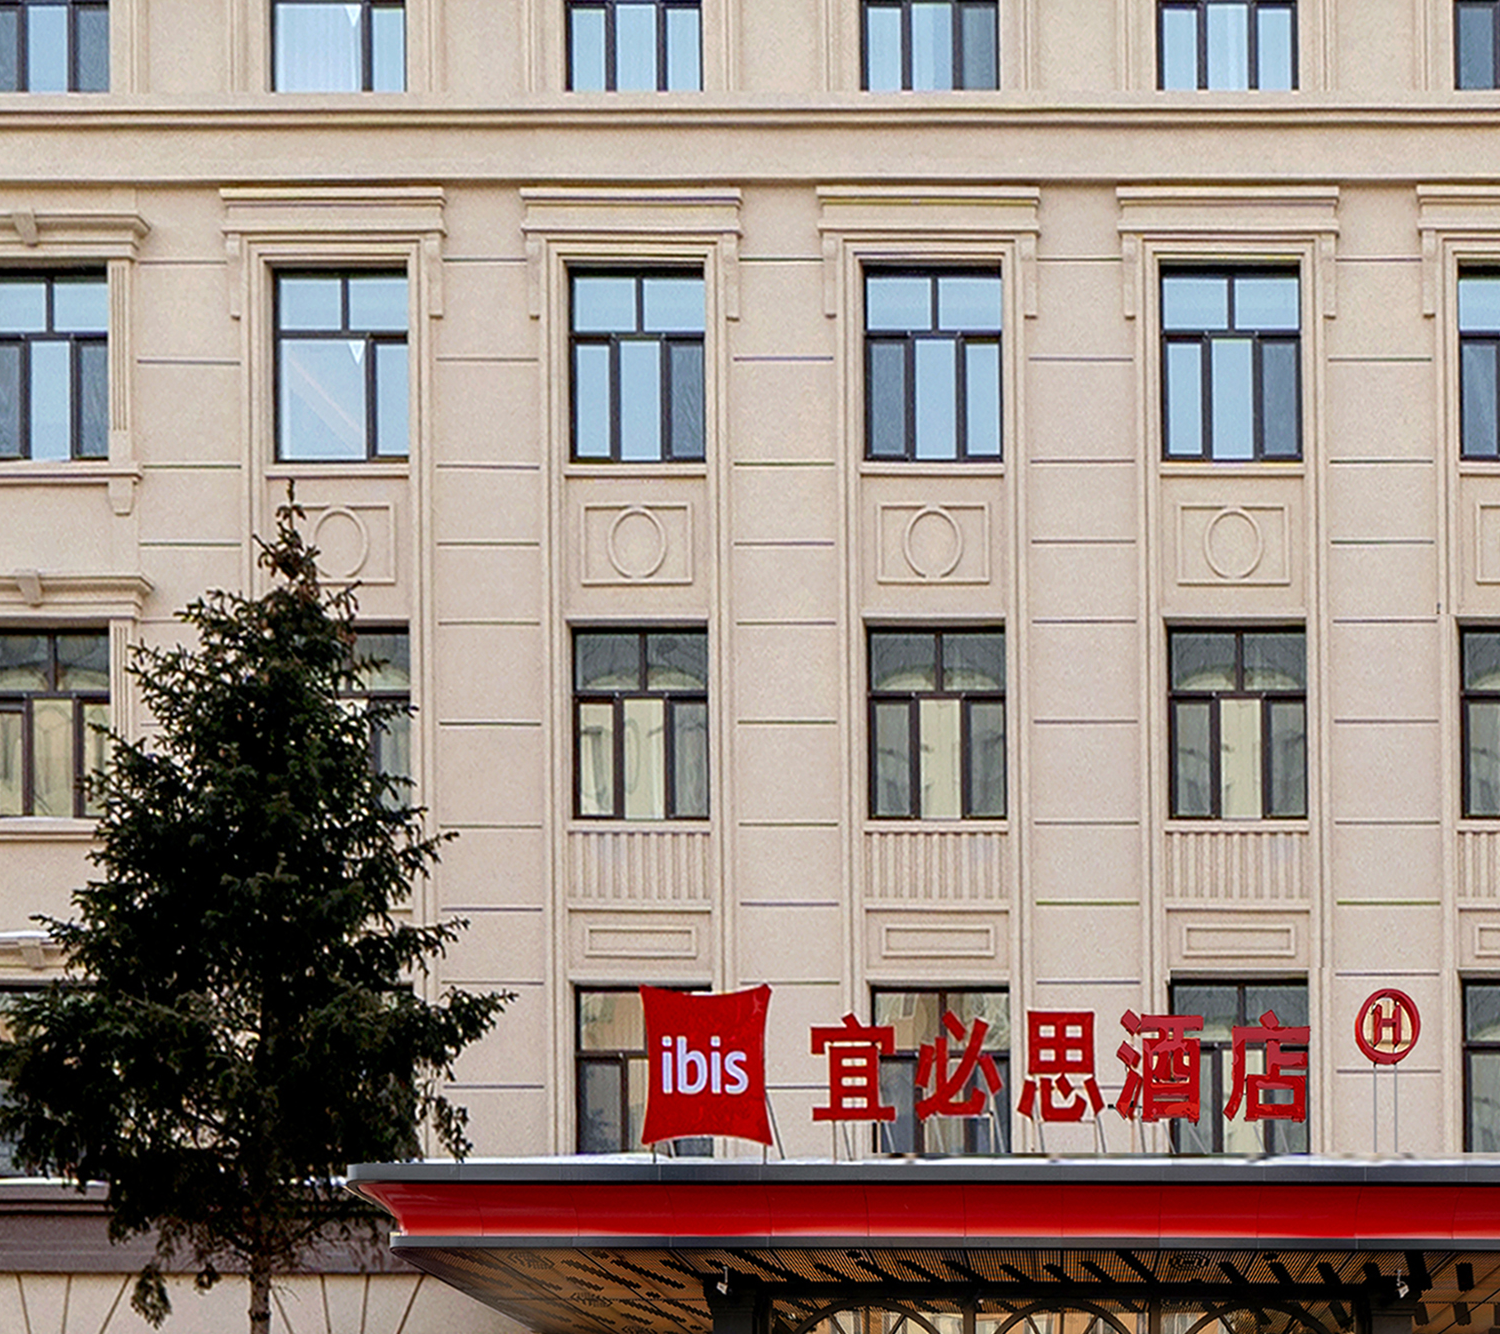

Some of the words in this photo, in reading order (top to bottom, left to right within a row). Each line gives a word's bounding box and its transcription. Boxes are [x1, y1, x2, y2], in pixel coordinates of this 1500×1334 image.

[661, 1035, 750, 1095] ibis
[809, 1009, 1311, 1123] 宜必思酒店
